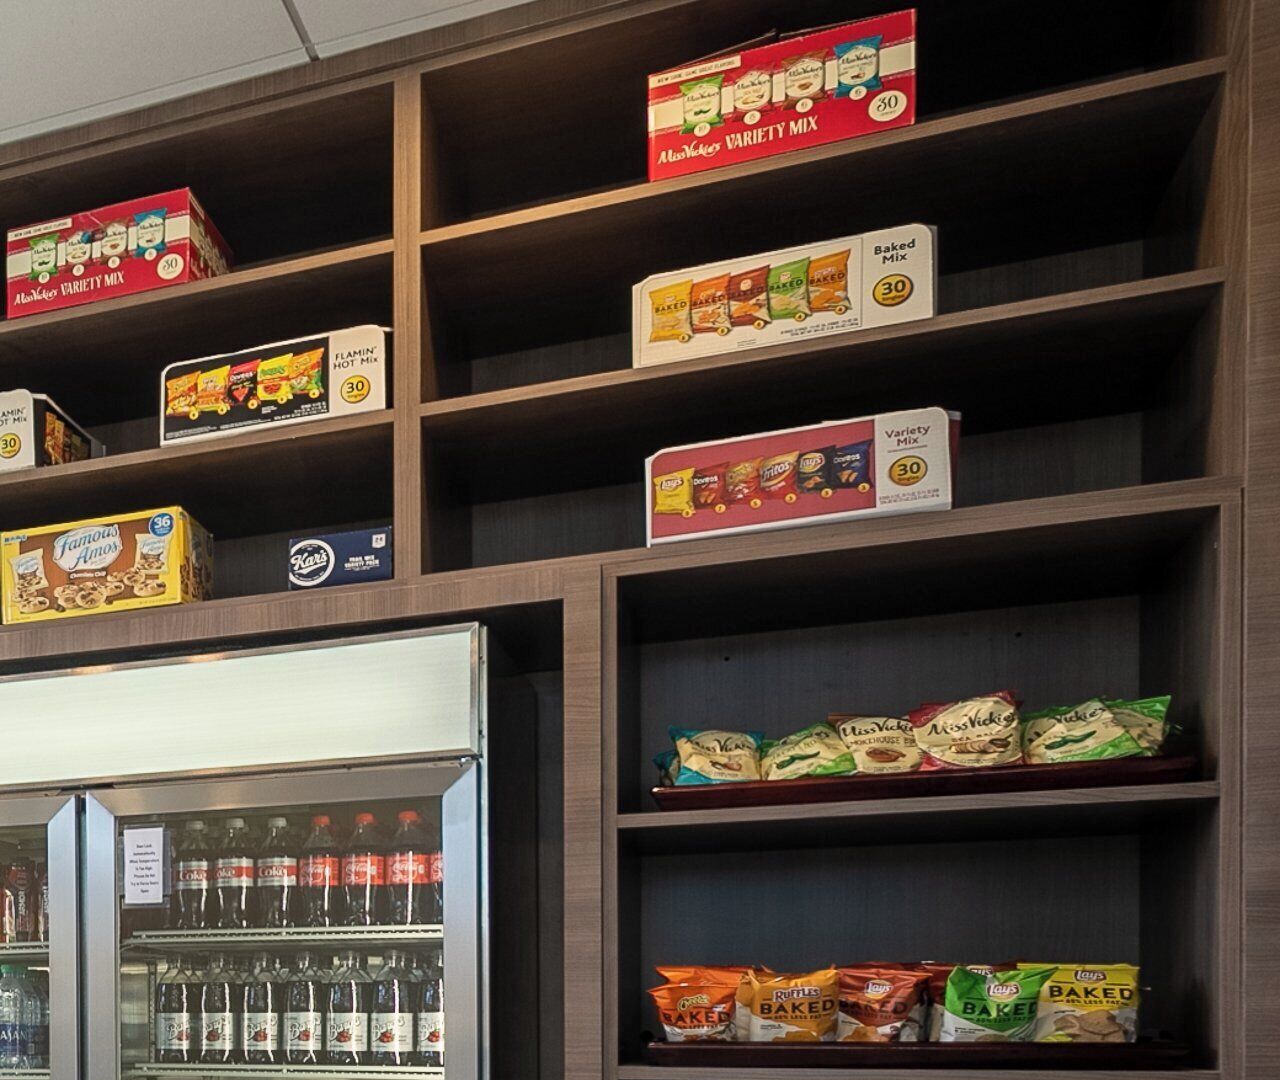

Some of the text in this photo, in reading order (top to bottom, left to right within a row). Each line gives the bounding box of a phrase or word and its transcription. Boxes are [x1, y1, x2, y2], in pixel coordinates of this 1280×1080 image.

[876, 95, 899, 112] 30
[725, 122, 785, 150] VARIETY
[790, 115, 818, 137] MIX
[873, 238, 916, 256] Baked
[163, 257, 178, 270] 30
[882, 252, 908, 264] Mix
[60, 277, 102, 296] VARIETY
[104, 271, 125, 287] MIX
[769, 279, 803, 290] BAKED
[810, 272, 845, 285] BAKED
[881, 279, 906, 296] 30
[655, 302, 687, 313] BAKED
[335, 346, 377, 362] FLAMIN'
[333, 355, 379, 370] HOT Mix
[345, 380, 364, 393] 30
[12, 414, 27, 424] Mix
[885, 425, 930, 439] Variety
[0, 438, 17, 449] 30
[897, 436, 919, 446] Mix
[763, 461, 790, 480] Fritos
[898, 462, 920, 476] 30
[153, 515, 170, 528] 36
[54, 524, 120, 561] Famous
[69, 541, 120, 570] Amos
[290, 550, 328, 571] Kar's
[1055, 706, 1107, 724] Vickie's
[928, 711, 1017, 736] Miss Vickie's
[773, 986, 821, 1002] RUFFLES
[1049, 985, 1134, 1000] BAKED
[760, 999, 835, 1015] BAKED
[962, 1002, 1036, 1016] BAKED
[662, 1010, 730, 1024] BAKED
